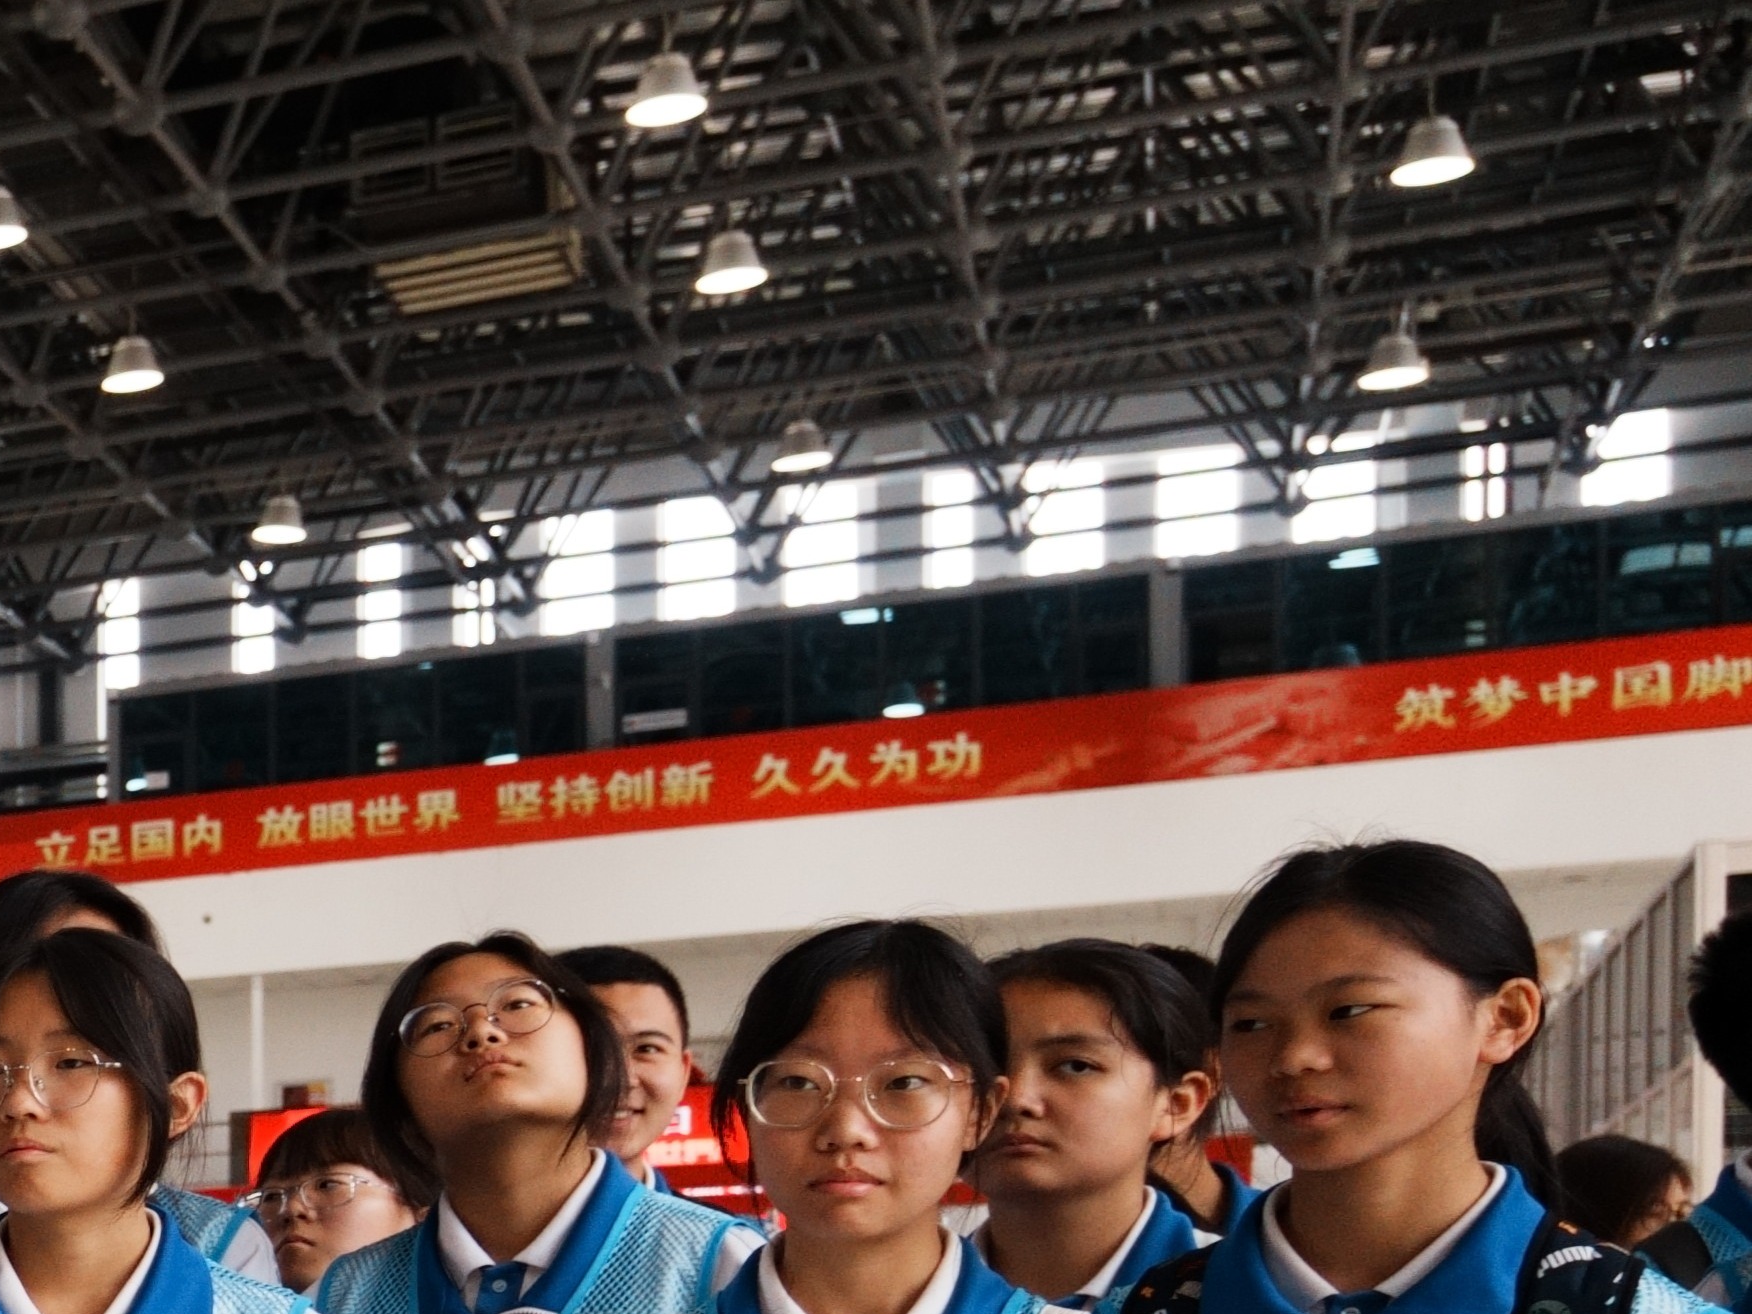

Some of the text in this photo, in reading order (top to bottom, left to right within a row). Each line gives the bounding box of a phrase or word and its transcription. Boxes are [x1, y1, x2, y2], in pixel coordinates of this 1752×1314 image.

[35, 731, 982, 870] 立足国内 放眼世界 坚持创新 久久为功
